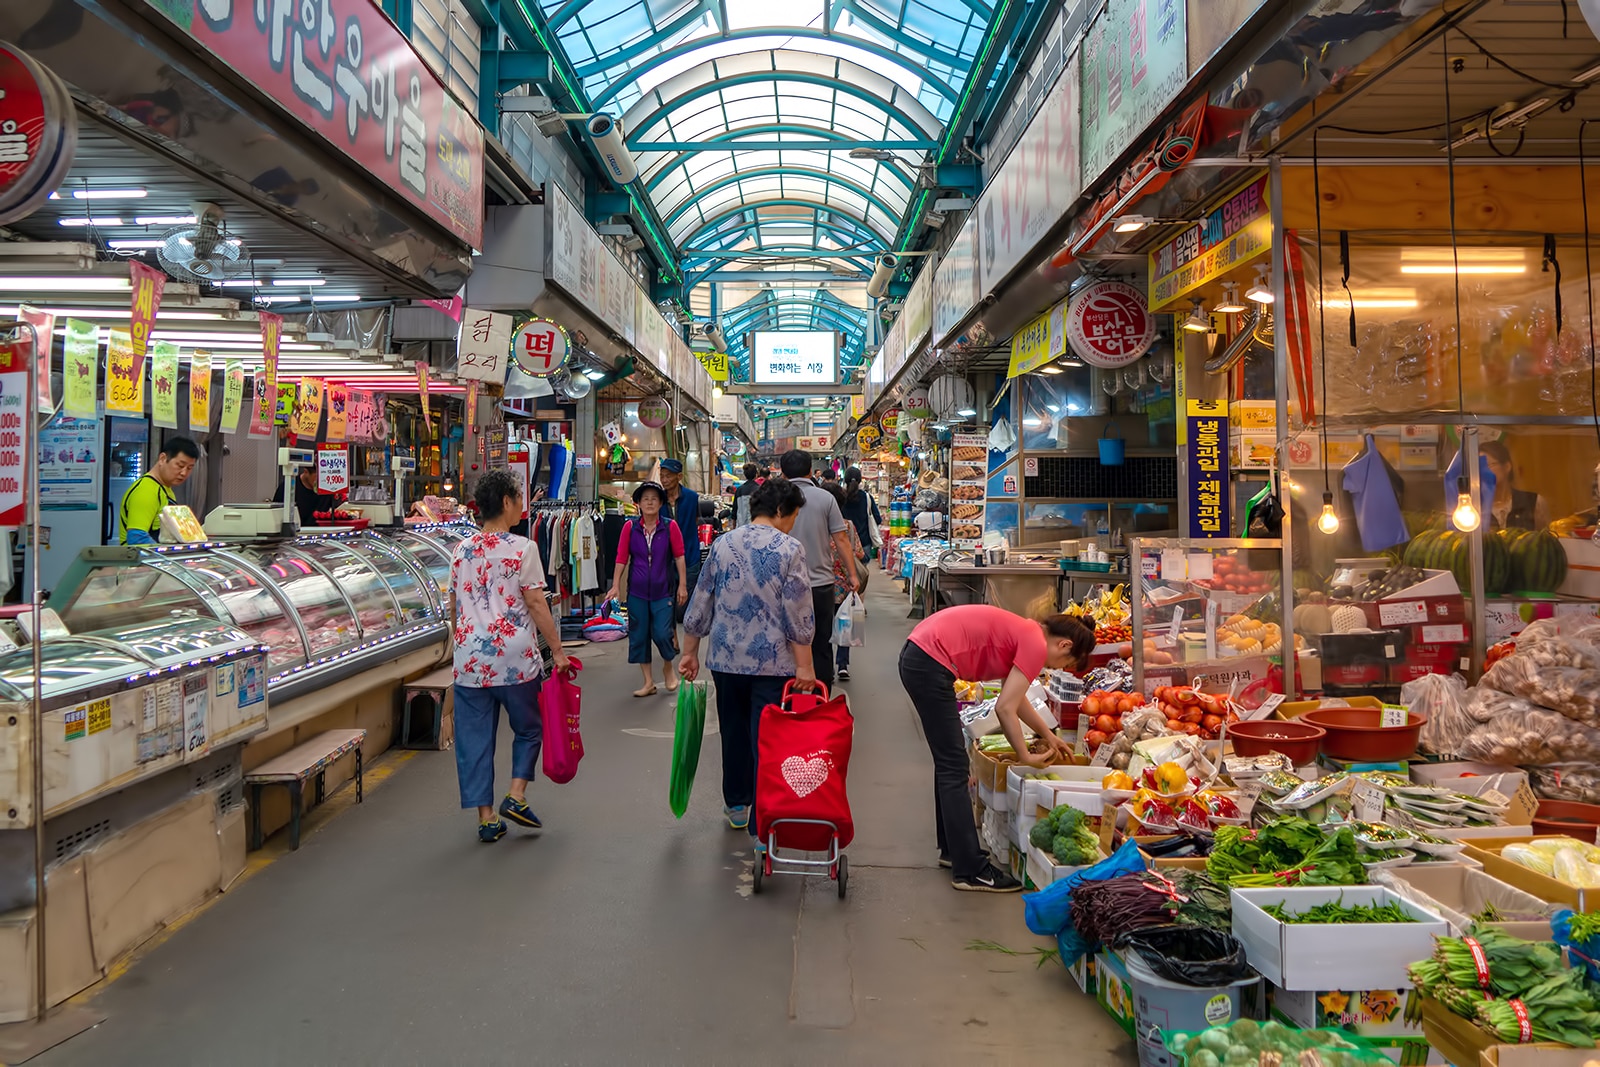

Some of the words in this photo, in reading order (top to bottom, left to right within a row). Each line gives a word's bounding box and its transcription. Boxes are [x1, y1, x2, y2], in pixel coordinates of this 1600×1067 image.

[133, 277, 154, 357] 세일
[1075, 292, 1093, 317] BUSAN
[1093, 283, 1112, 296] UMUK
[460, 352, 498, 372] 오리
[523, 329, 556, 368] 떡
[770, 363, 801, 374] 변화하는
[807, 362, 823, 374] 시장
